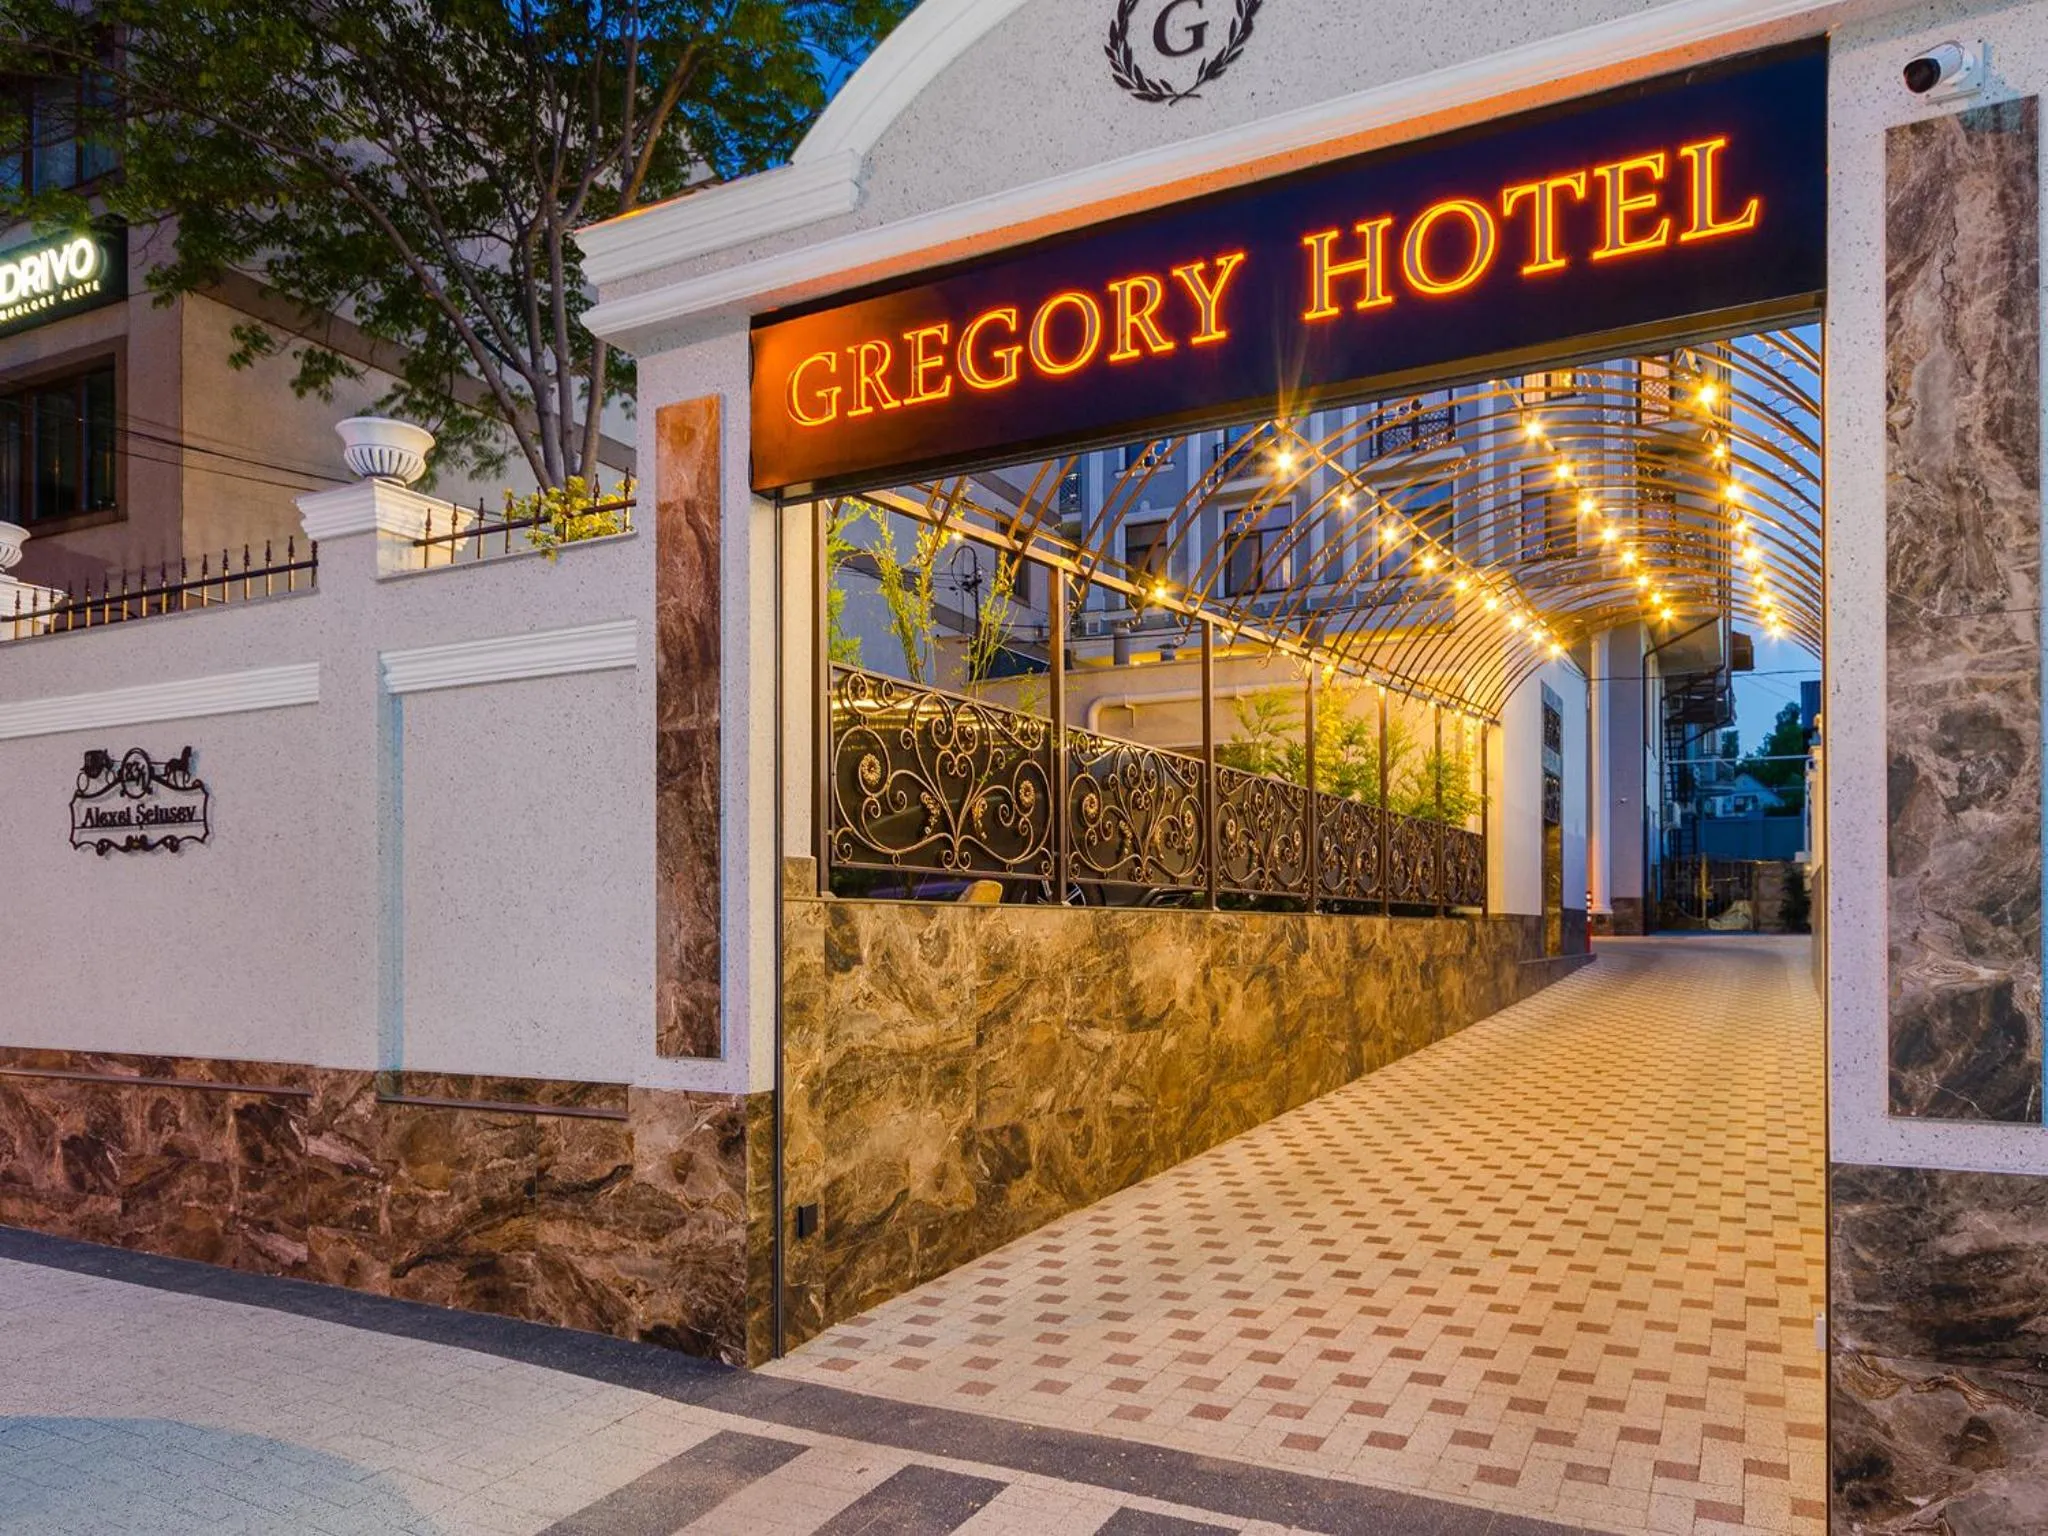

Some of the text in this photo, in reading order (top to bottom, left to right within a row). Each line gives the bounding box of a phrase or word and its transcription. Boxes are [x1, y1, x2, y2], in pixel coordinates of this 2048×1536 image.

[1152, 0, 1209, 57] G
[62, 279, 101, 301] ALIVE
[785, 137, 1759, 427] GREGORY HOTEL
